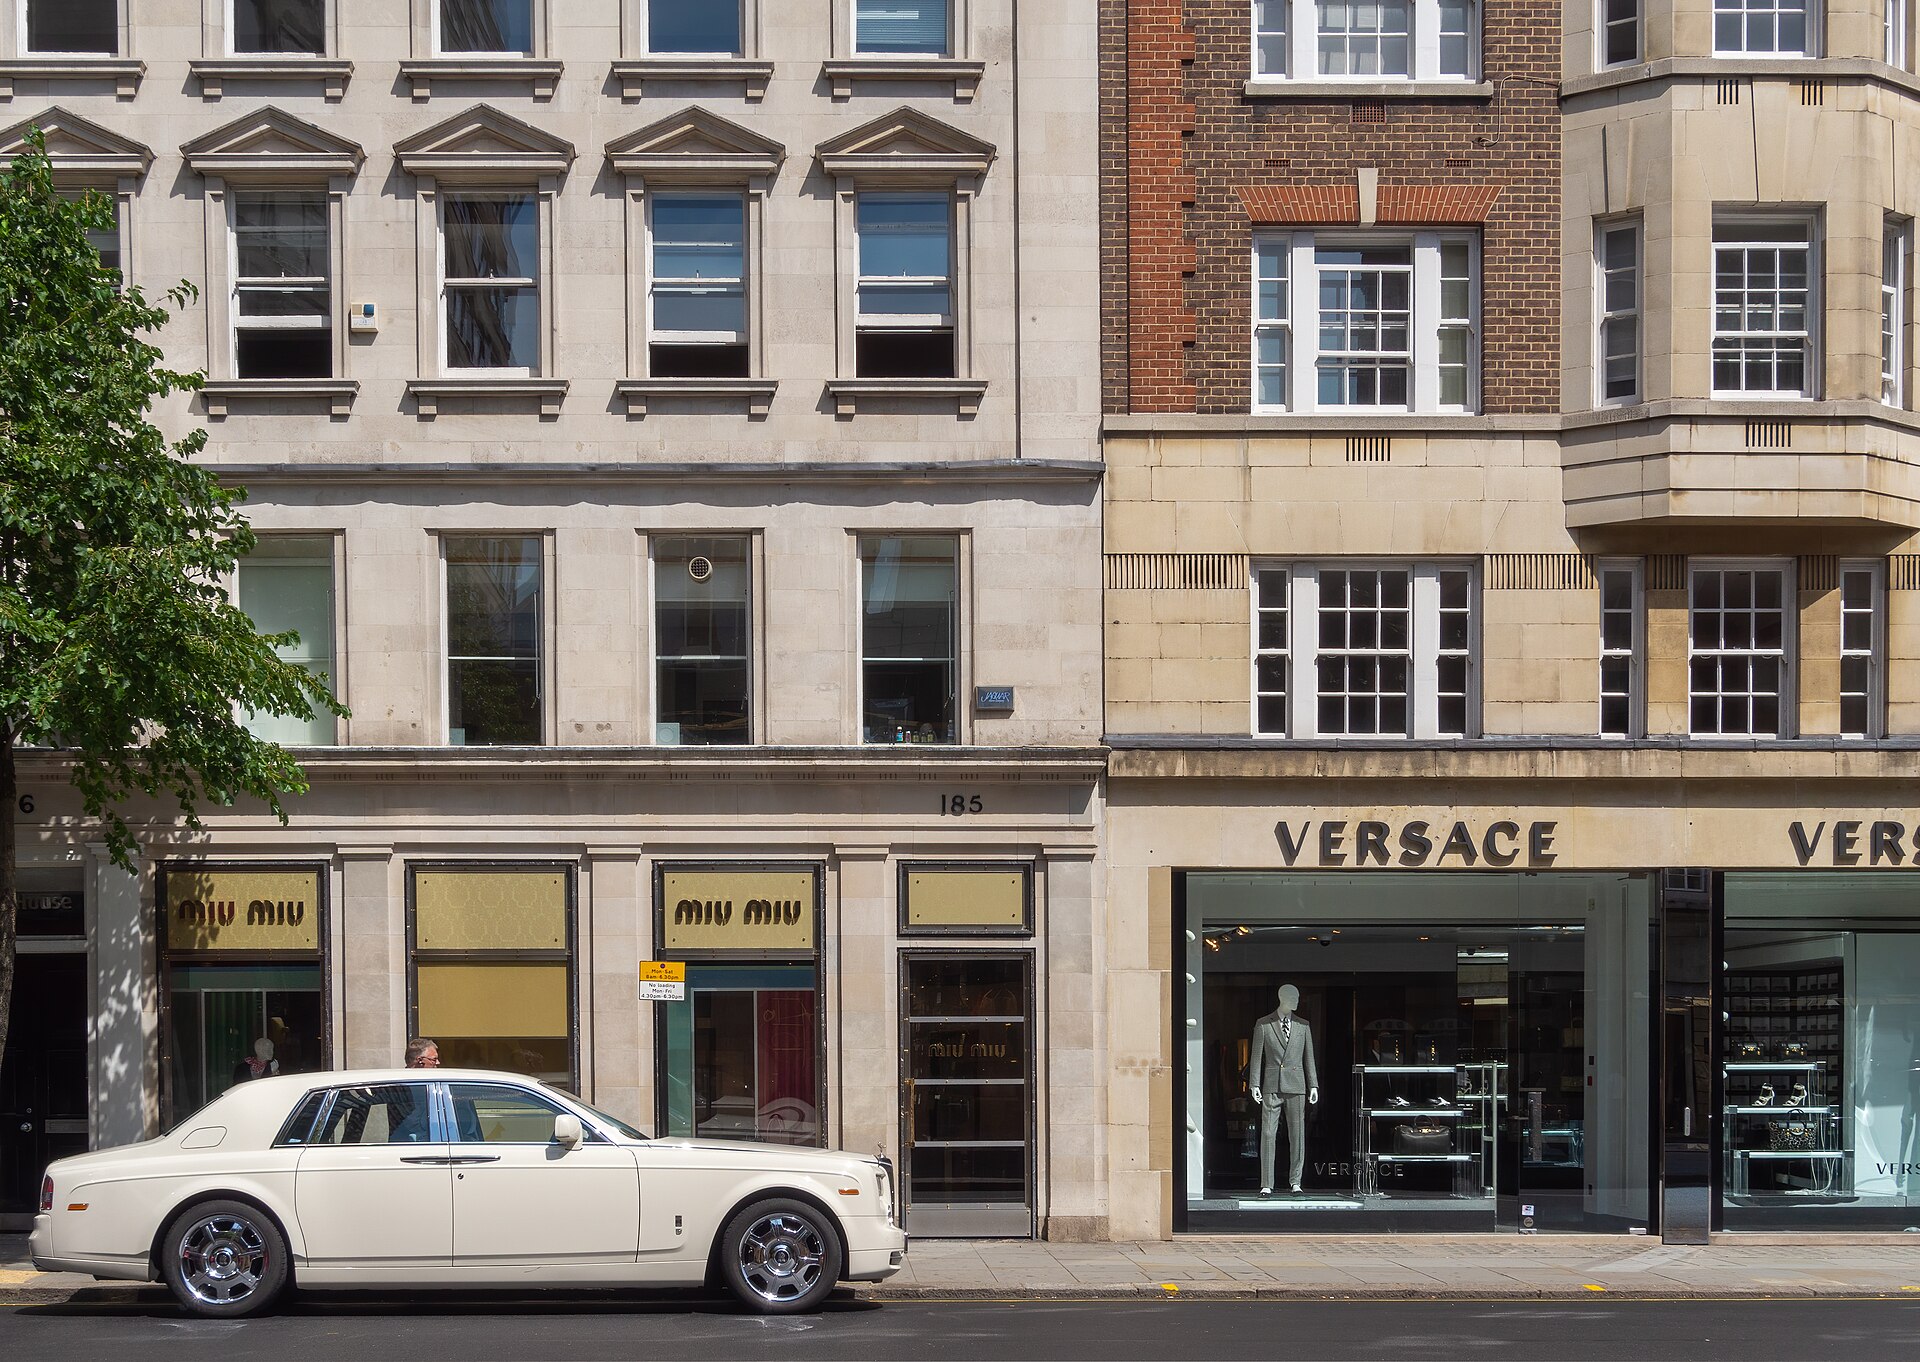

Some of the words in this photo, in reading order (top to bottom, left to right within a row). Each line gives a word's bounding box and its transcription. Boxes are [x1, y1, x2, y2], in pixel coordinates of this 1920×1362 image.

[940, 794, 983, 816] 185
[1274, 821, 1558, 867] VERSACE
[1788, 821, 1920, 867] VER
[1313, 1162, 1404, 1177] VERSACE
